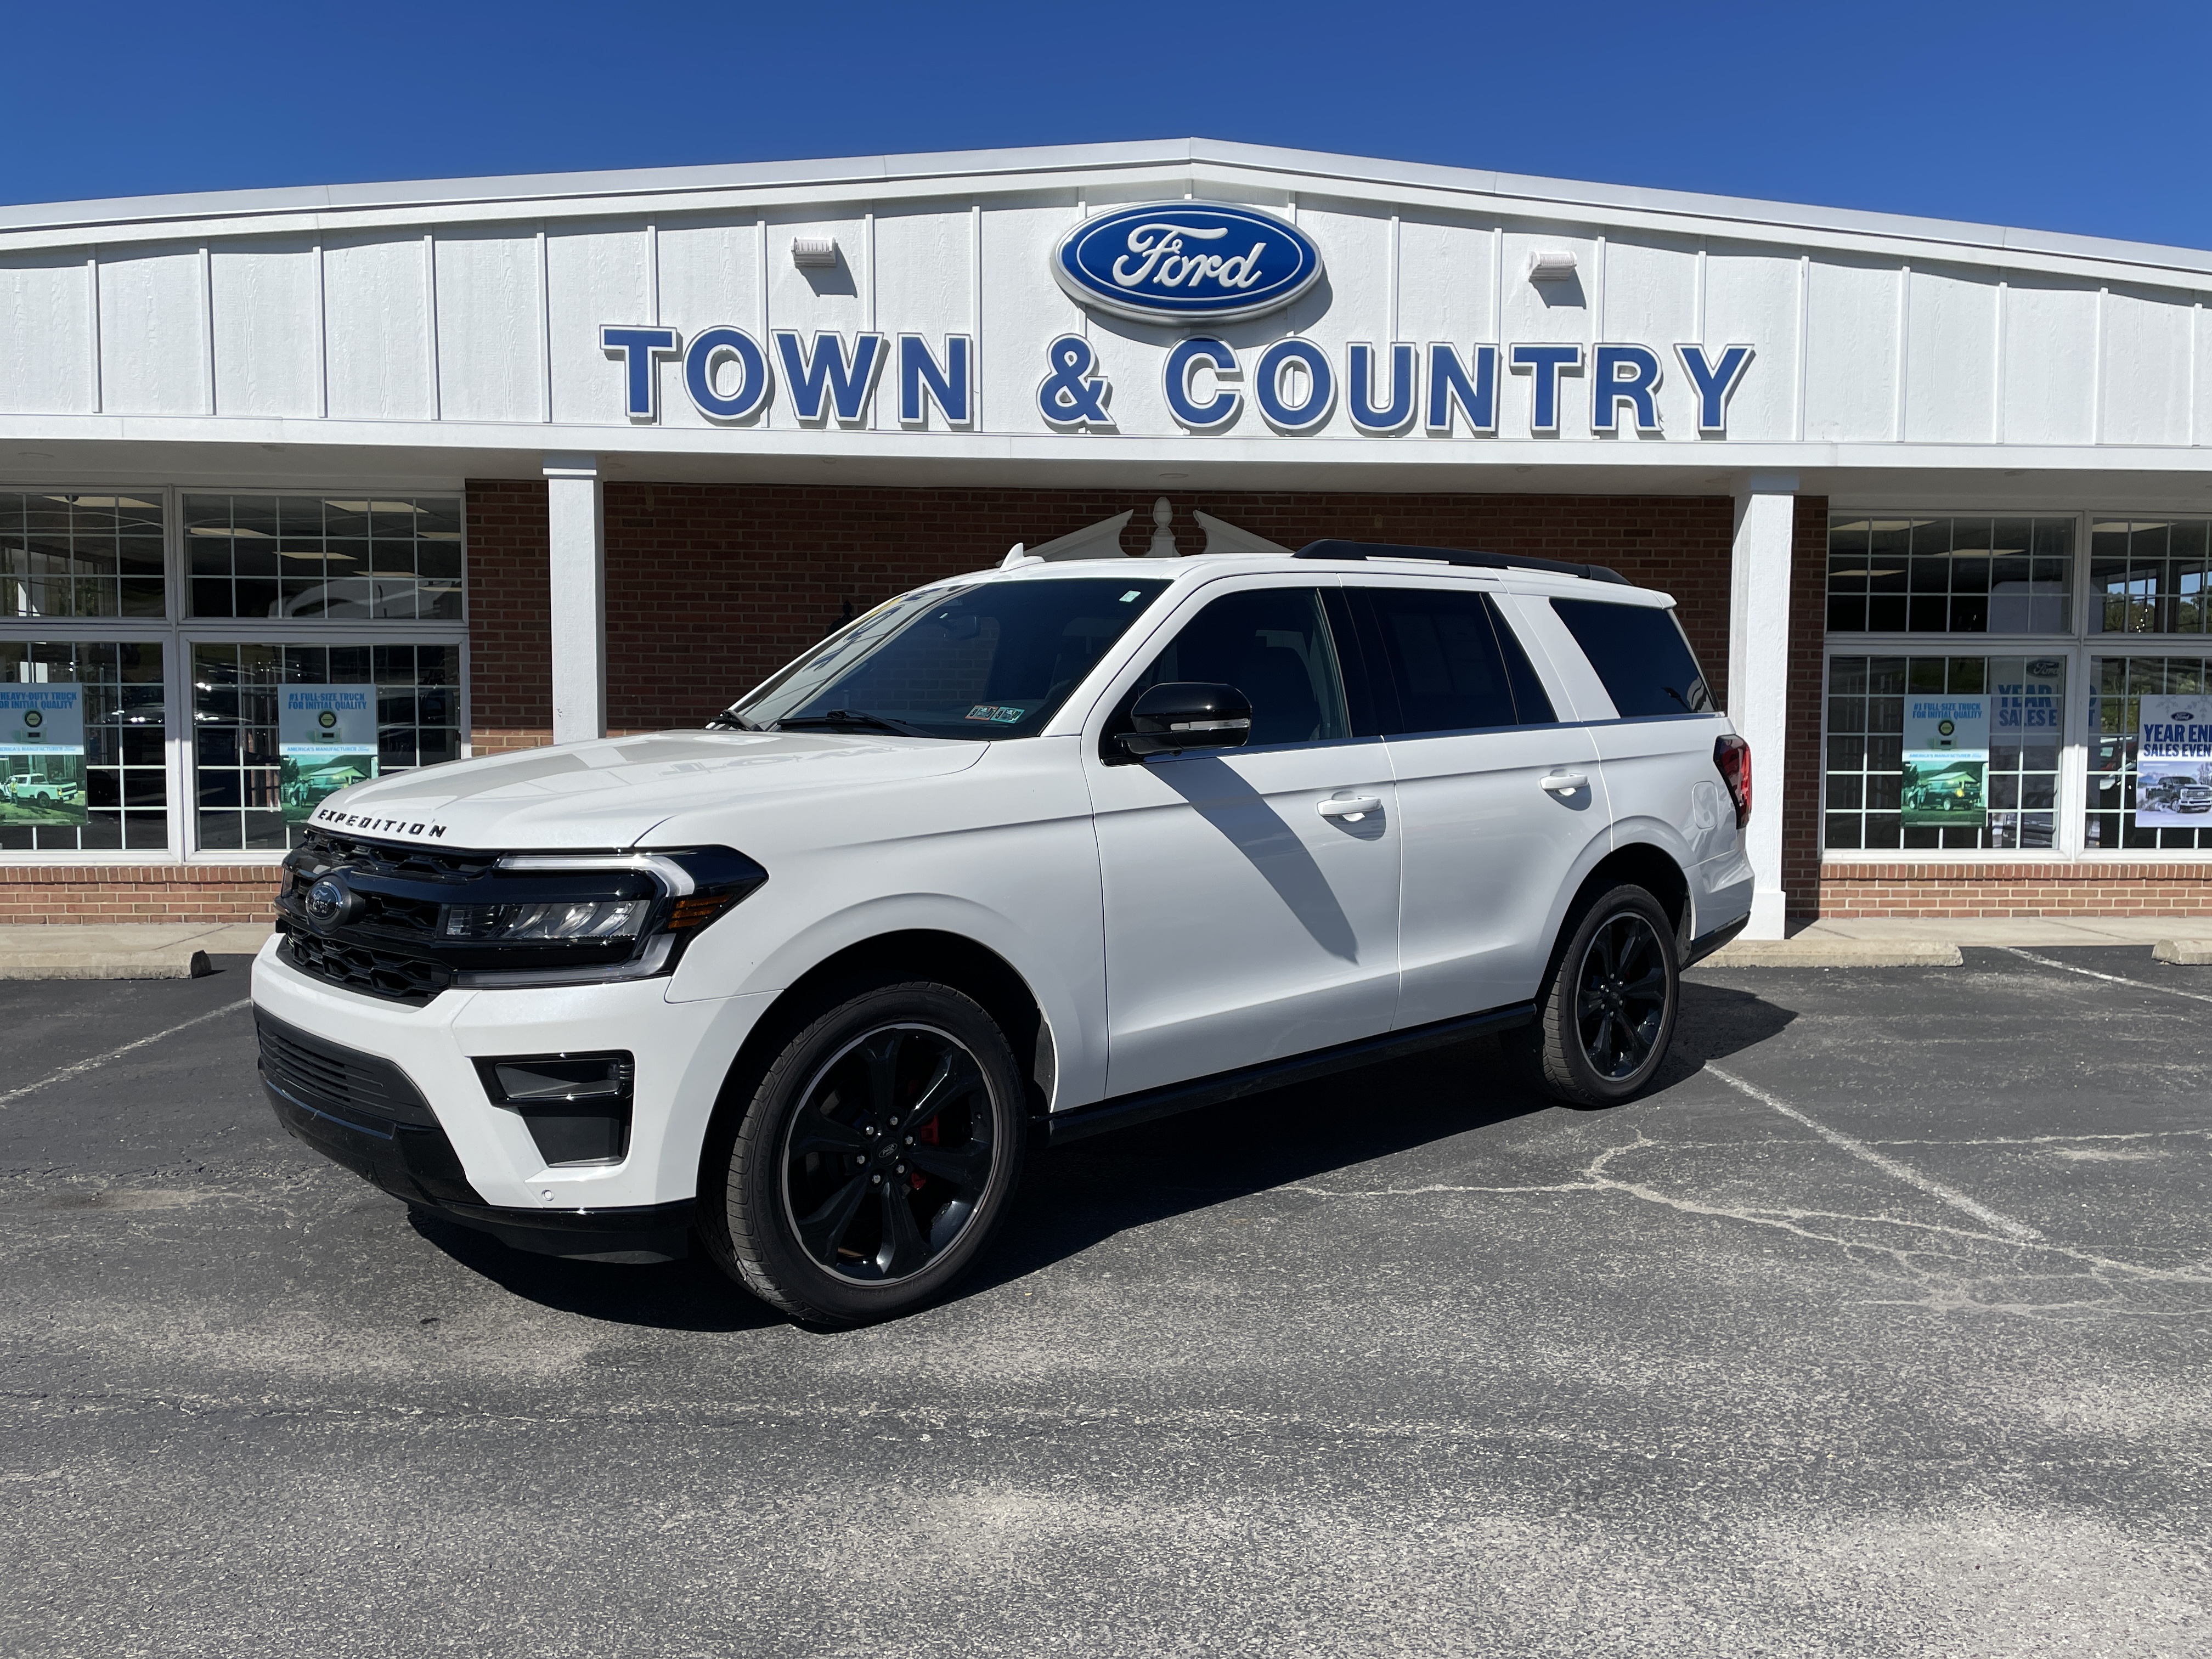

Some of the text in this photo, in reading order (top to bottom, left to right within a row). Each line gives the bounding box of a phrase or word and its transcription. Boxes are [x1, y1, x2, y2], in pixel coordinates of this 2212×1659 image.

[1113, 223, 1266, 288] Ford
[600, 325, 1754, 432] TOWN & COUNTRY
[0, 692, 77, 700] HEAVY-DUTY TRUCK
[289, 692, 298, 701] #1
[1998, 684, 2052, 708] YEAR
[0, 701, 74, 710] OR INITIAL QUALITY
[335, 702, 367, 711] QUALITY
[1923, 703, 1956, 711] FULL-SIZE
[1958, 703, 1981, 711] TRUCK
[1912, 710, 1982, 720] FOR INITIAL QUALITY
[1999, 709, 2046, 726] SALES
[2144, 724, 2186, 742] YEAR
[2143, 743, 2212, 757] SALES EVEN
[318, 809, 447, 838] EXPEDITION
